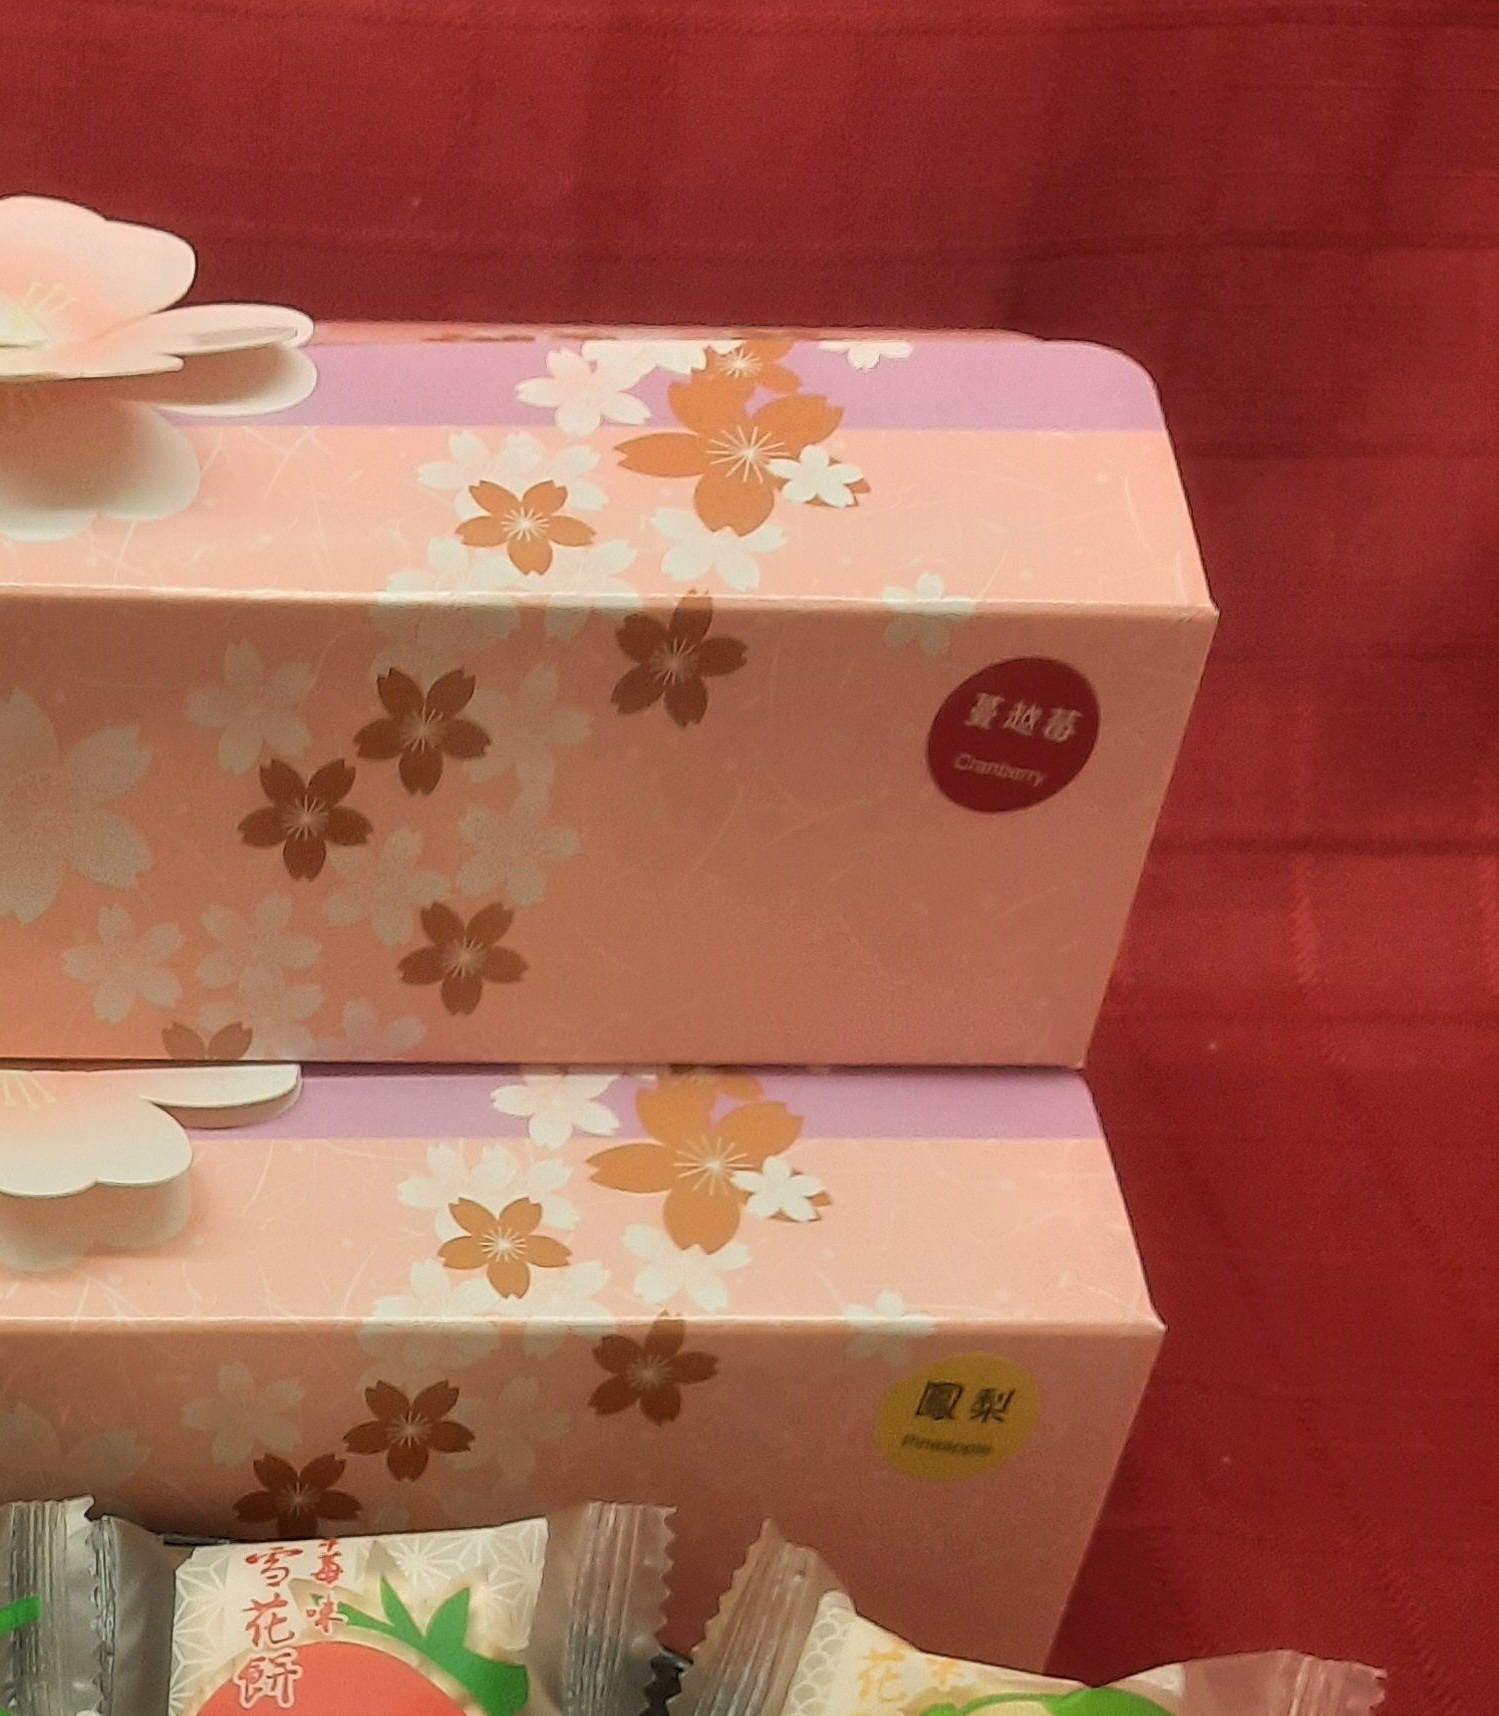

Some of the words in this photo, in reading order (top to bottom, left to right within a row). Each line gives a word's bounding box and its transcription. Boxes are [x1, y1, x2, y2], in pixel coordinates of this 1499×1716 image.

[954, 752, 1049, 788] Cranberry
[238, 1546, 303, 1706] 雪花餅
